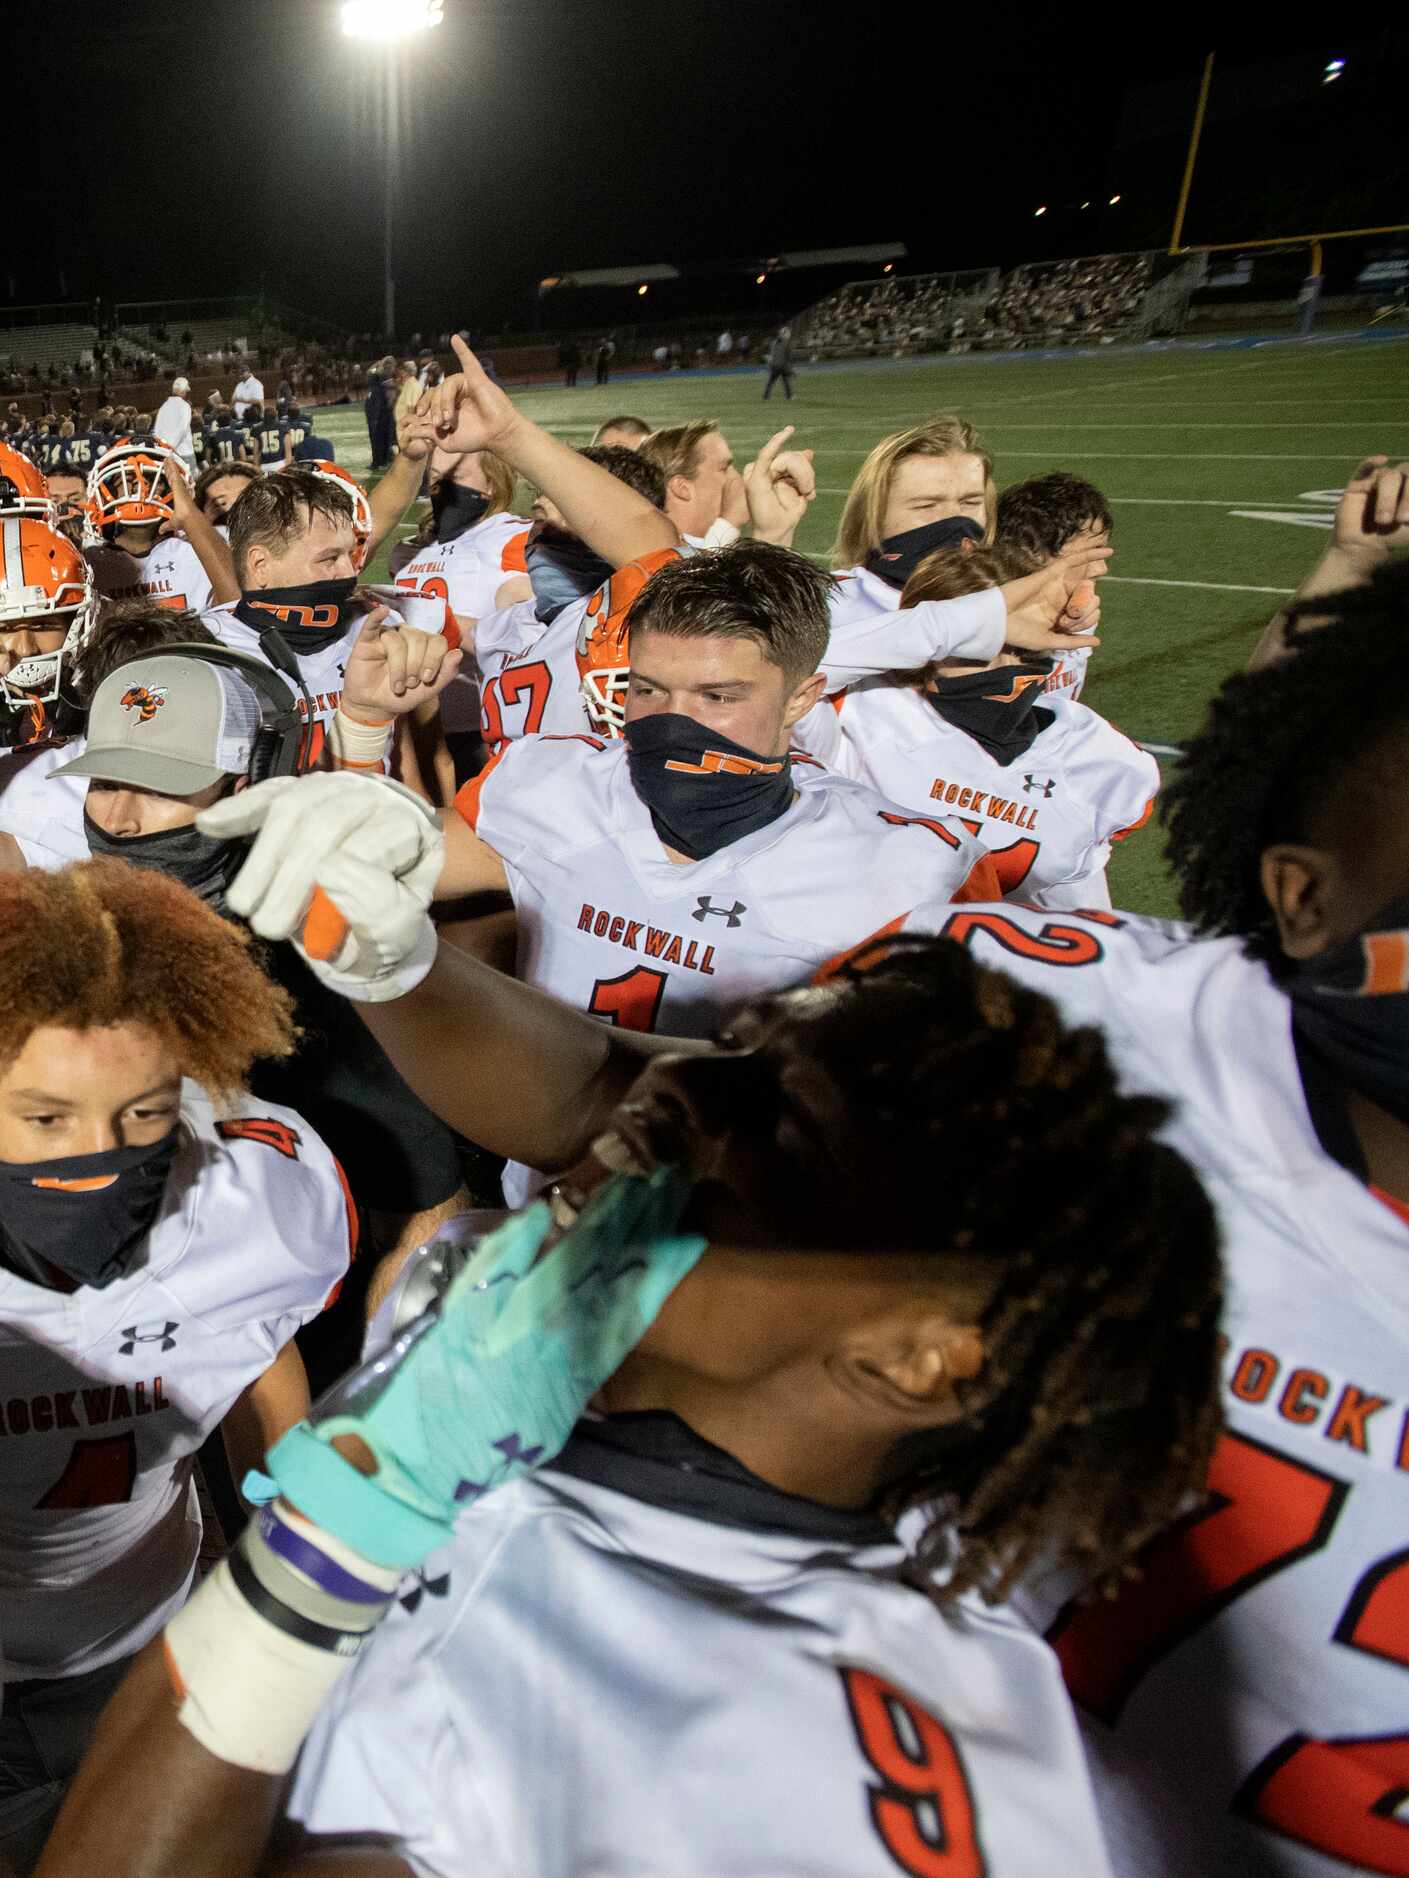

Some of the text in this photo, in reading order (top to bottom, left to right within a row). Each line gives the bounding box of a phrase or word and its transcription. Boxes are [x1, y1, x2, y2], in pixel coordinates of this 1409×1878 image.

[71, 440, 91, 463] 75
[262, 430, 280, 453] 15
[929, 778, 1038, 831] ROCKWALL
[577, 904, 715, 975] ROCKWALL
[588, 965, 669, 1034] 1
[835, 1666, 994, 1878] 9
